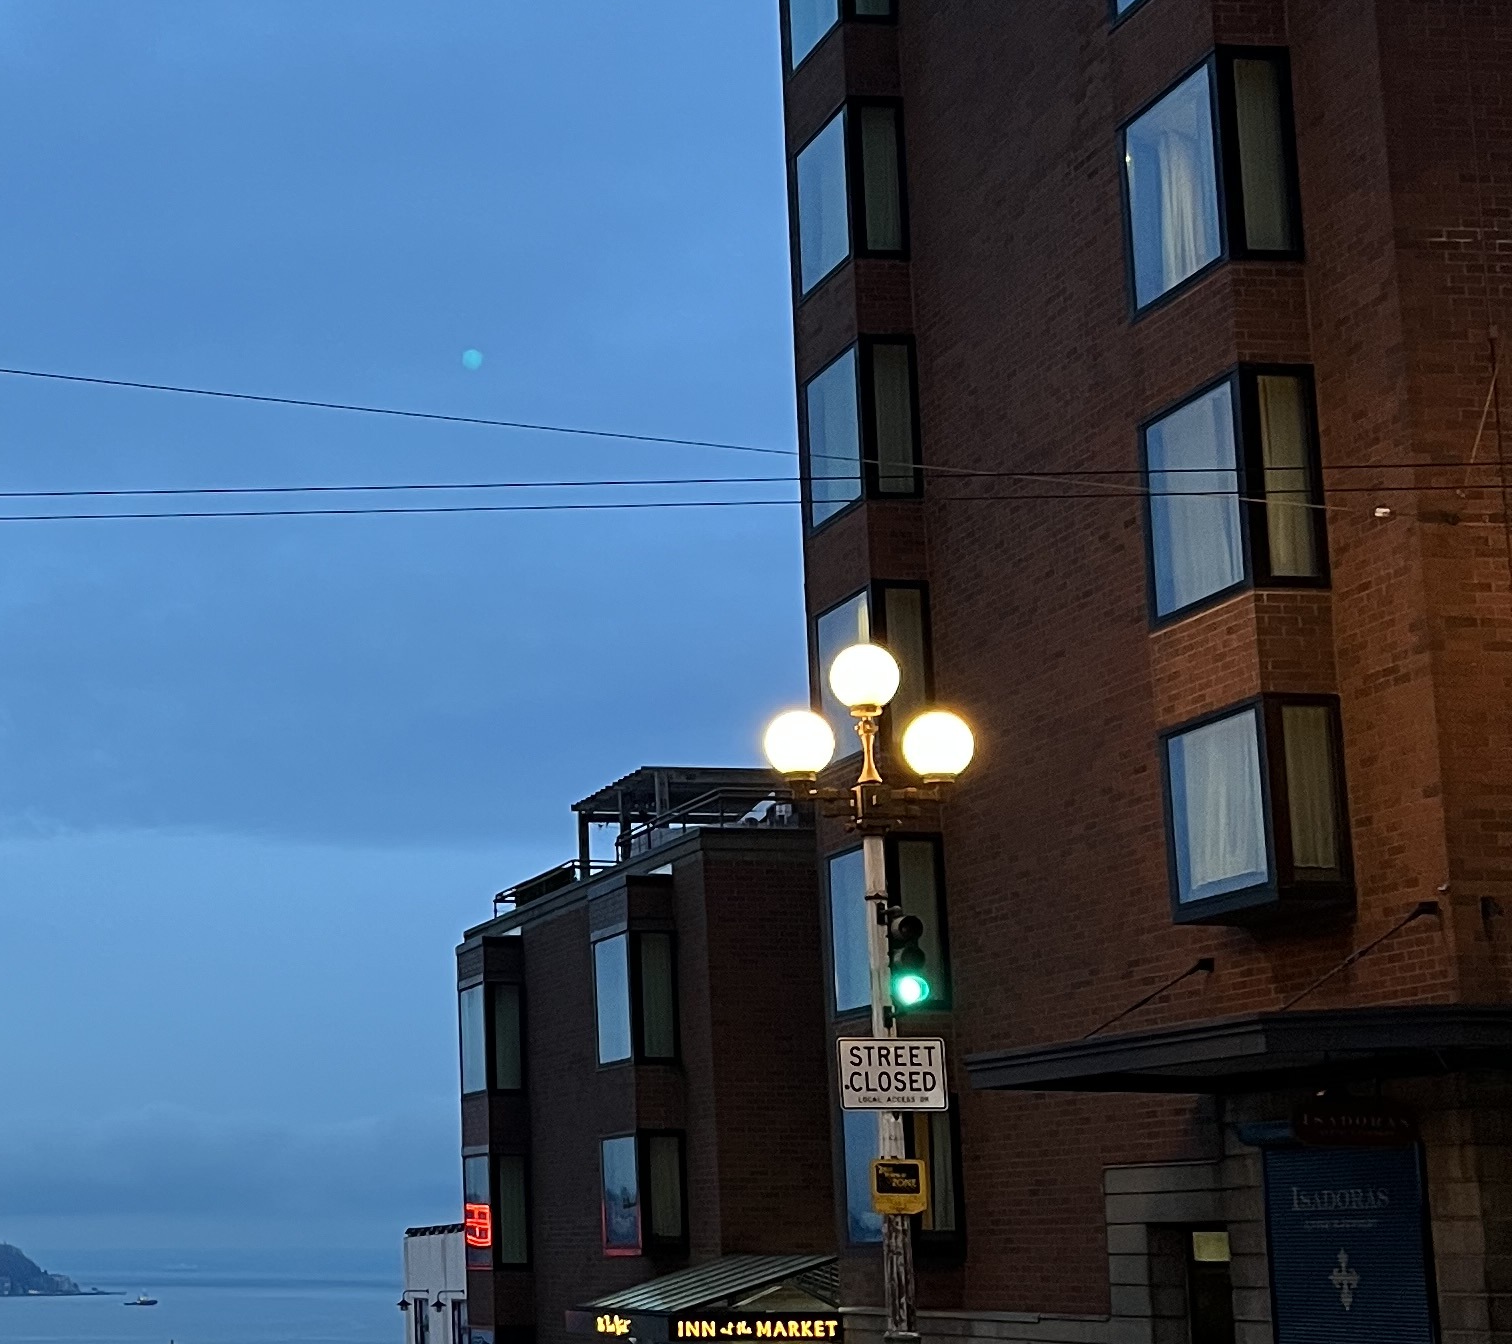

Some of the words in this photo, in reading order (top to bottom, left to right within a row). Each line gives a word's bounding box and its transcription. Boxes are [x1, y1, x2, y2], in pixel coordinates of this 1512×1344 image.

[849, 1046, 935, 1067] STREET
[849, 1071, 936, 1092] CLOSED
[677, 1320, 716, 1338] INN
[755, 1320, 838, 1338] MARKET
